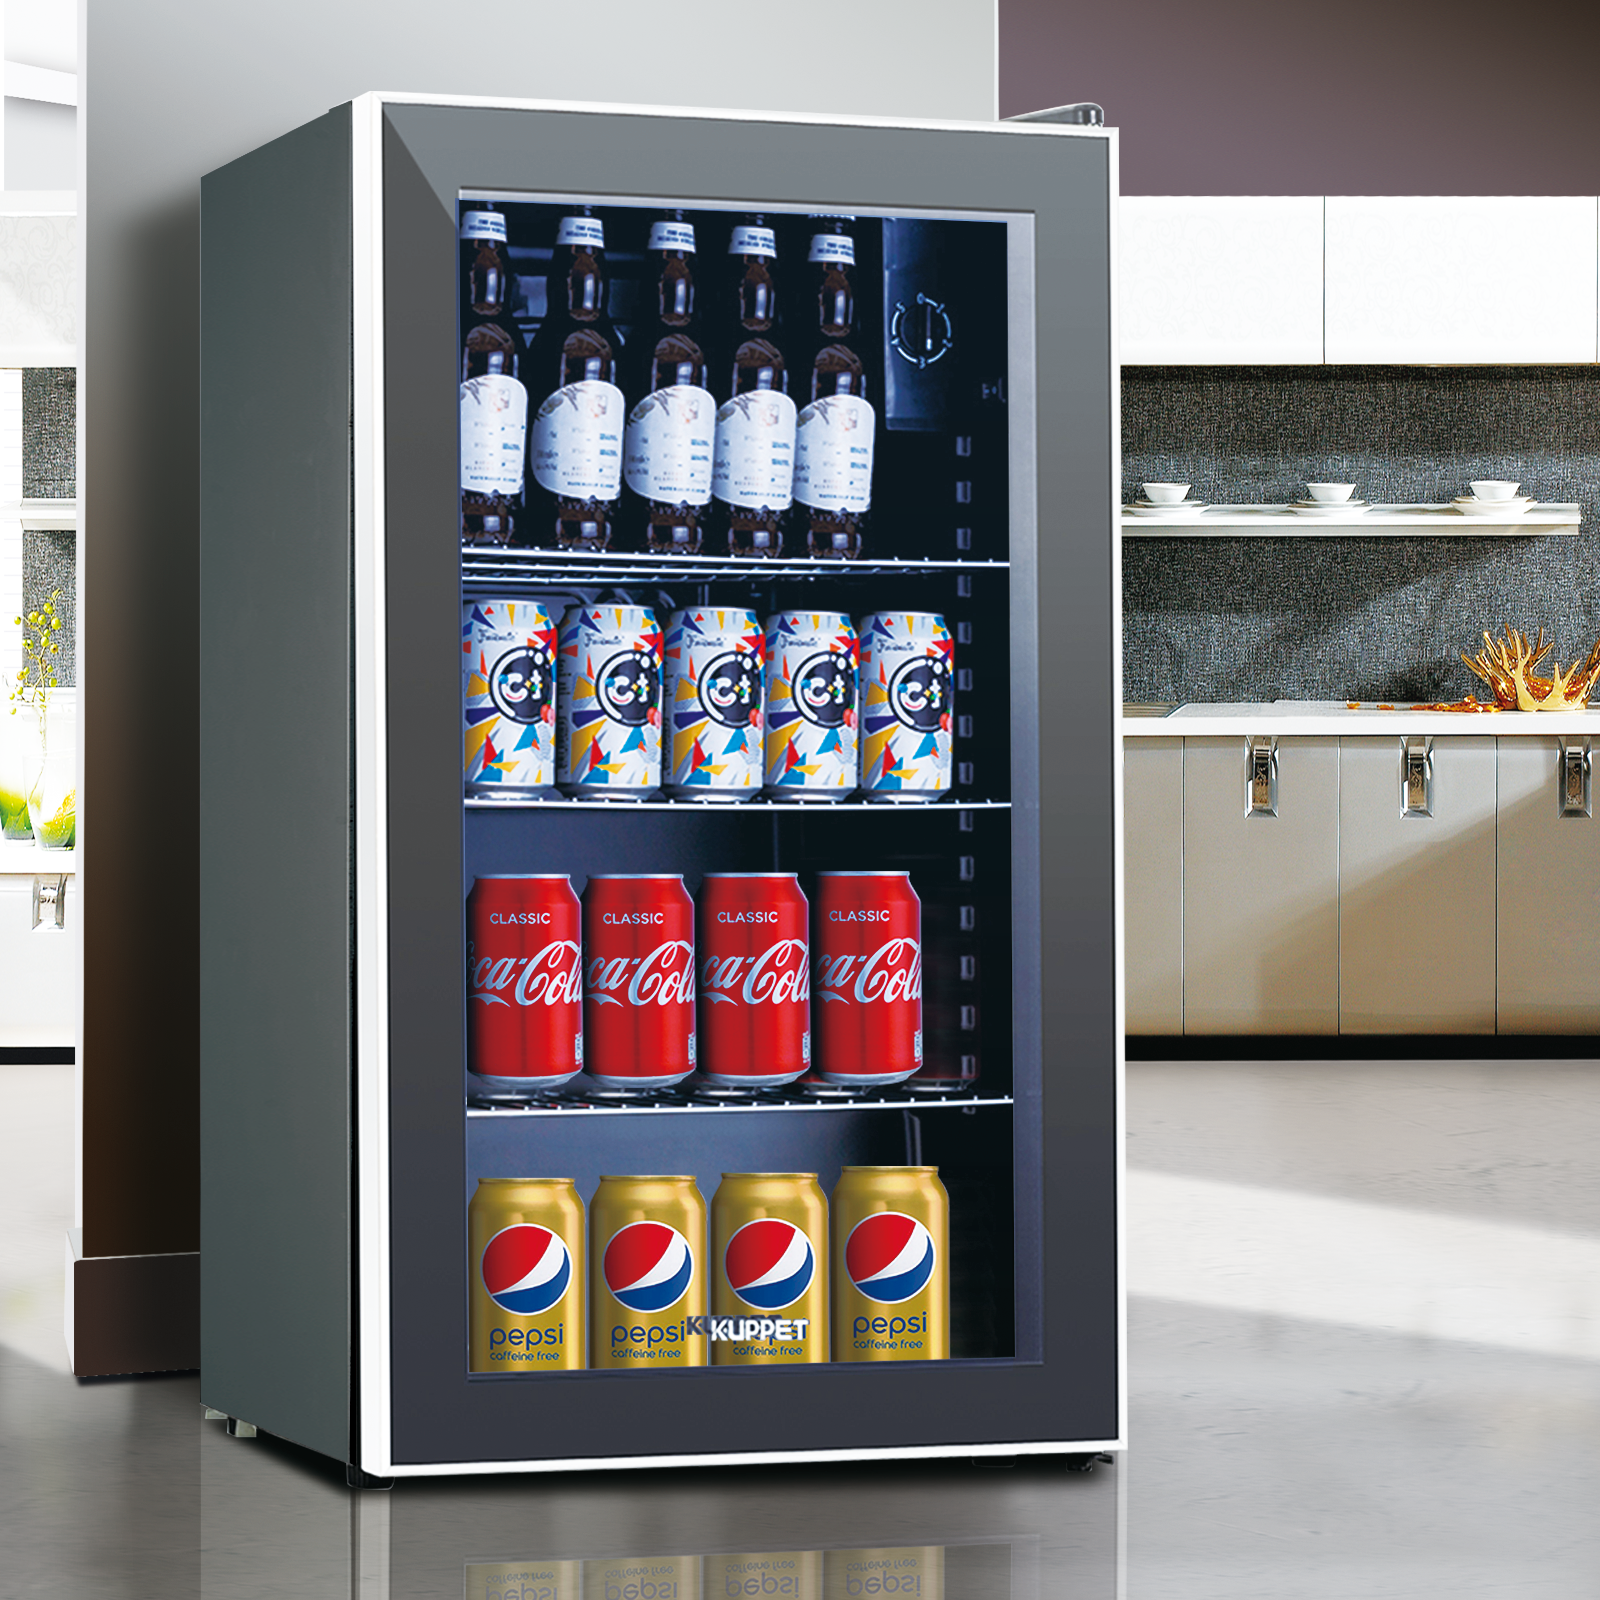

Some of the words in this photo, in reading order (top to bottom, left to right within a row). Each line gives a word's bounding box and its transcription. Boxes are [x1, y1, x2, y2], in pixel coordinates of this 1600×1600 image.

[490, 912, 551, 925] CLASSIC
[603, 912, 664, 925] CLASSIC
[717, 911, 778, 923] CLASSIC
[829, 910, 890, 922] CLASSIC
[711, 1319, 810, 1341] KUPPET
[853, 1311, 927, 1339] pepsi
[490, 1323, 563, 1351] pepsi
[611, 1320, 685, 1348] pepsi
[733, 1345, 777, 1356] caffeine
[780, 1345, 803, 1355] free
[853, 1339, 898, 1350] caffeine
[900, 1339, 923, 1349] free
[489, 1350, 534, 1361] caffeine
[537, 1350, 560, 1361] free
[611, 1348, 656, 1359] caffeine
[658, 1348, 681, 1358] free
